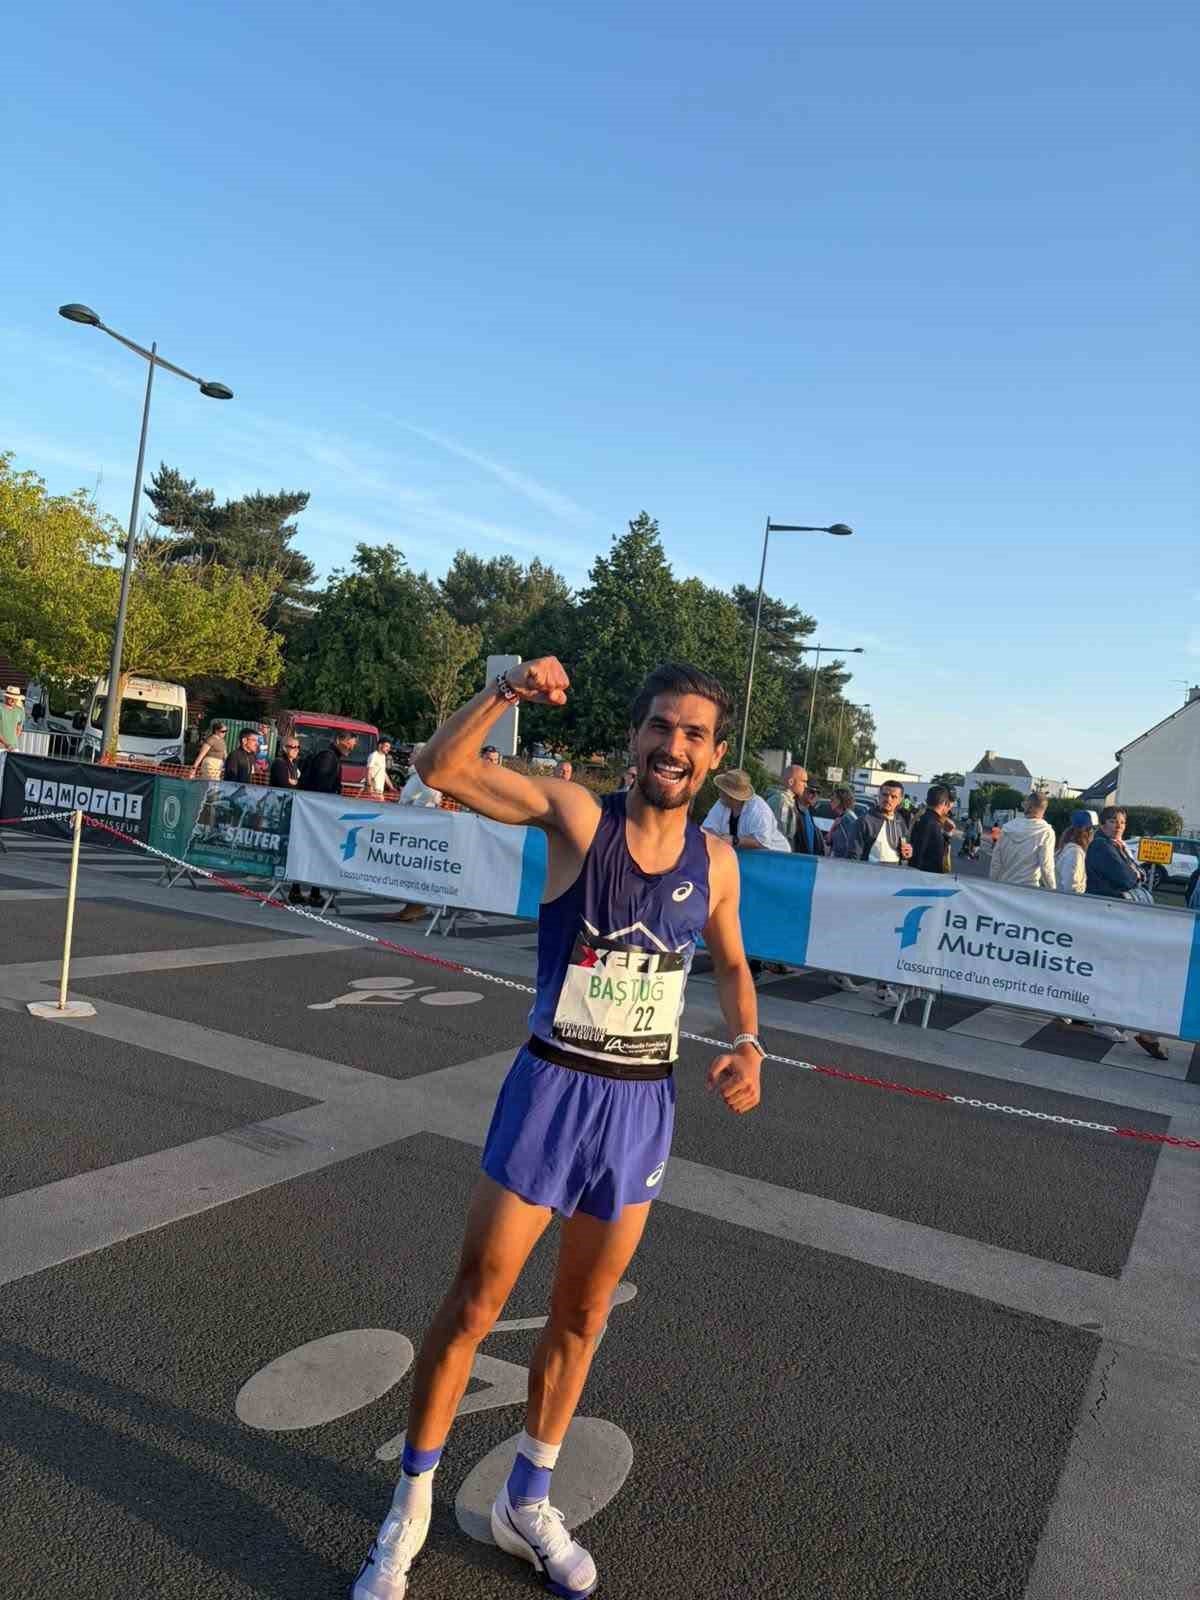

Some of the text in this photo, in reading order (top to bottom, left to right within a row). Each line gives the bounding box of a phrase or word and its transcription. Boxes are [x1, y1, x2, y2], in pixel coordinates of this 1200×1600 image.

[27, 782, 140, 815] LAMOTTE
[224, 826, 281, 850] SAUTER
[370, 829, 449, 852] la France
[367, 847, 462, 875] Mutualiste
[944, 909, 1074, 949] la France
[937, 932, 1094, 977] Mutualiste
[588, 975, 665, 1007] BAŞTUĞ
[896, 959, 1090, 1005] L'assurance d'un esprit de famille
[633, 1006, 655, 1033] 22
